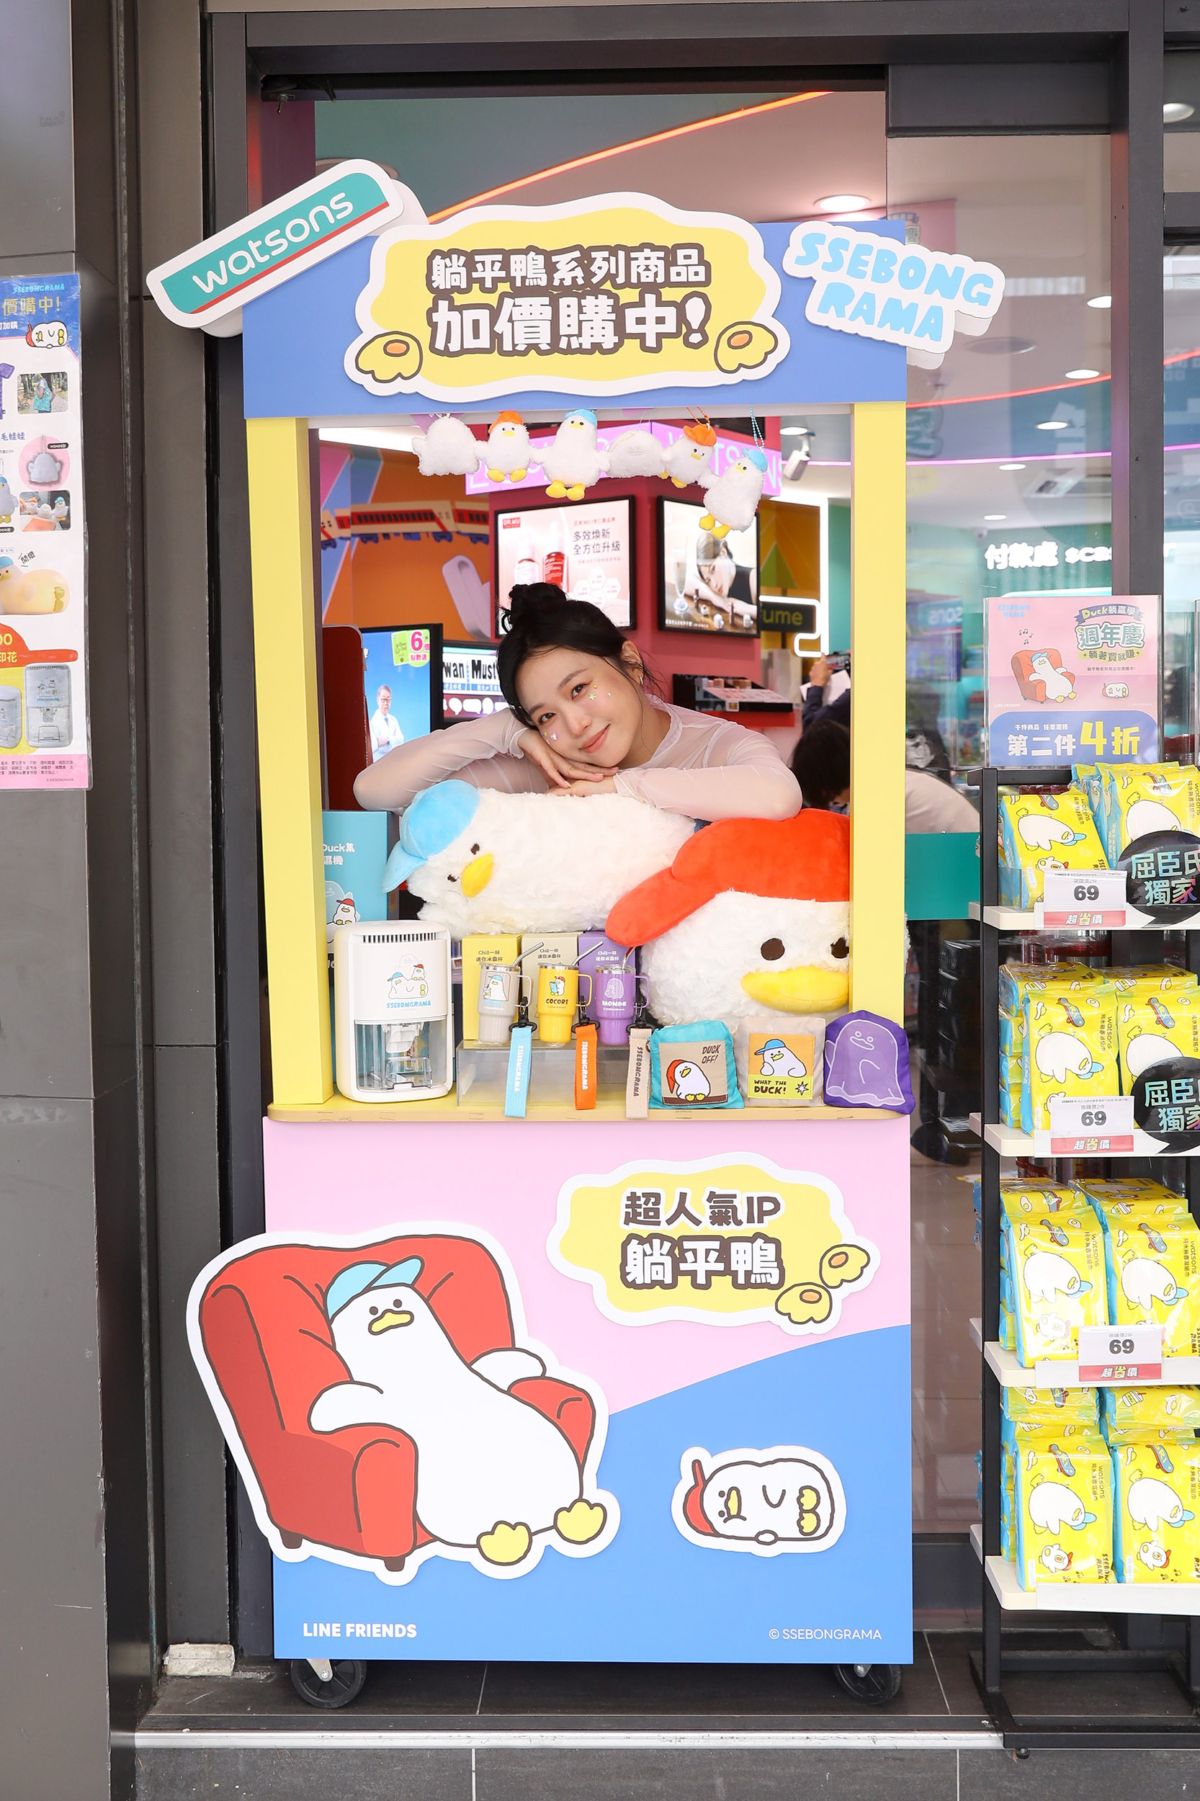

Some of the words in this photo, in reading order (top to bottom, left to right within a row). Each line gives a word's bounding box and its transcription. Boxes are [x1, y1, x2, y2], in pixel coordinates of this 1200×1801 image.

[192, 192, 353, 293] watsons
[429, 246, 708, 291] 躺平鴨系列商品
[795, 233, 993, 306] SSEBONG
[430, 292, 708, 352] 加價購中!
[817, 282, 943, 342] RAMA
[573, 541, 621, 556] 全方位升級
[410, 630, 424, 652] 6
[1078, 624, 1143, 648] 週年慶
[471, 659, 497, 680] Must
[1131, 850, 1200, 880] 屈臣氏
[1073, 885, 1100, 901] 69
[1144, 877, 1198, 907] 獨家
[1065, 912, 1104, 926] 超省價
[701, 1054, 719, 1064] OFF!
[702, 1044, 721, 1054] DUCK
[633, 1047, 643, 1097] SSEBONGRAMA
[754, 1086, 787, 1094] DUCK!
[1144, 1078, 1200, 1107] 屈臣
[1081, 1111, 1107, 1126] 69
[1073, 1137, 1111, 1151] 超省價
[623, 1190, 782, 1227] 超人氣IP
[623, 1235, 782, 1287] 躺平鴨
[1109, 1339, 1135, 1354] 69
[1101, 1366, 1138, 1379] 超省價
[303, 1622, 342, 1638] LINE
[346, 1623, 417, 1639] FRIENDS
[782, 1628, 883, 1640] SSEBONGRAMA
